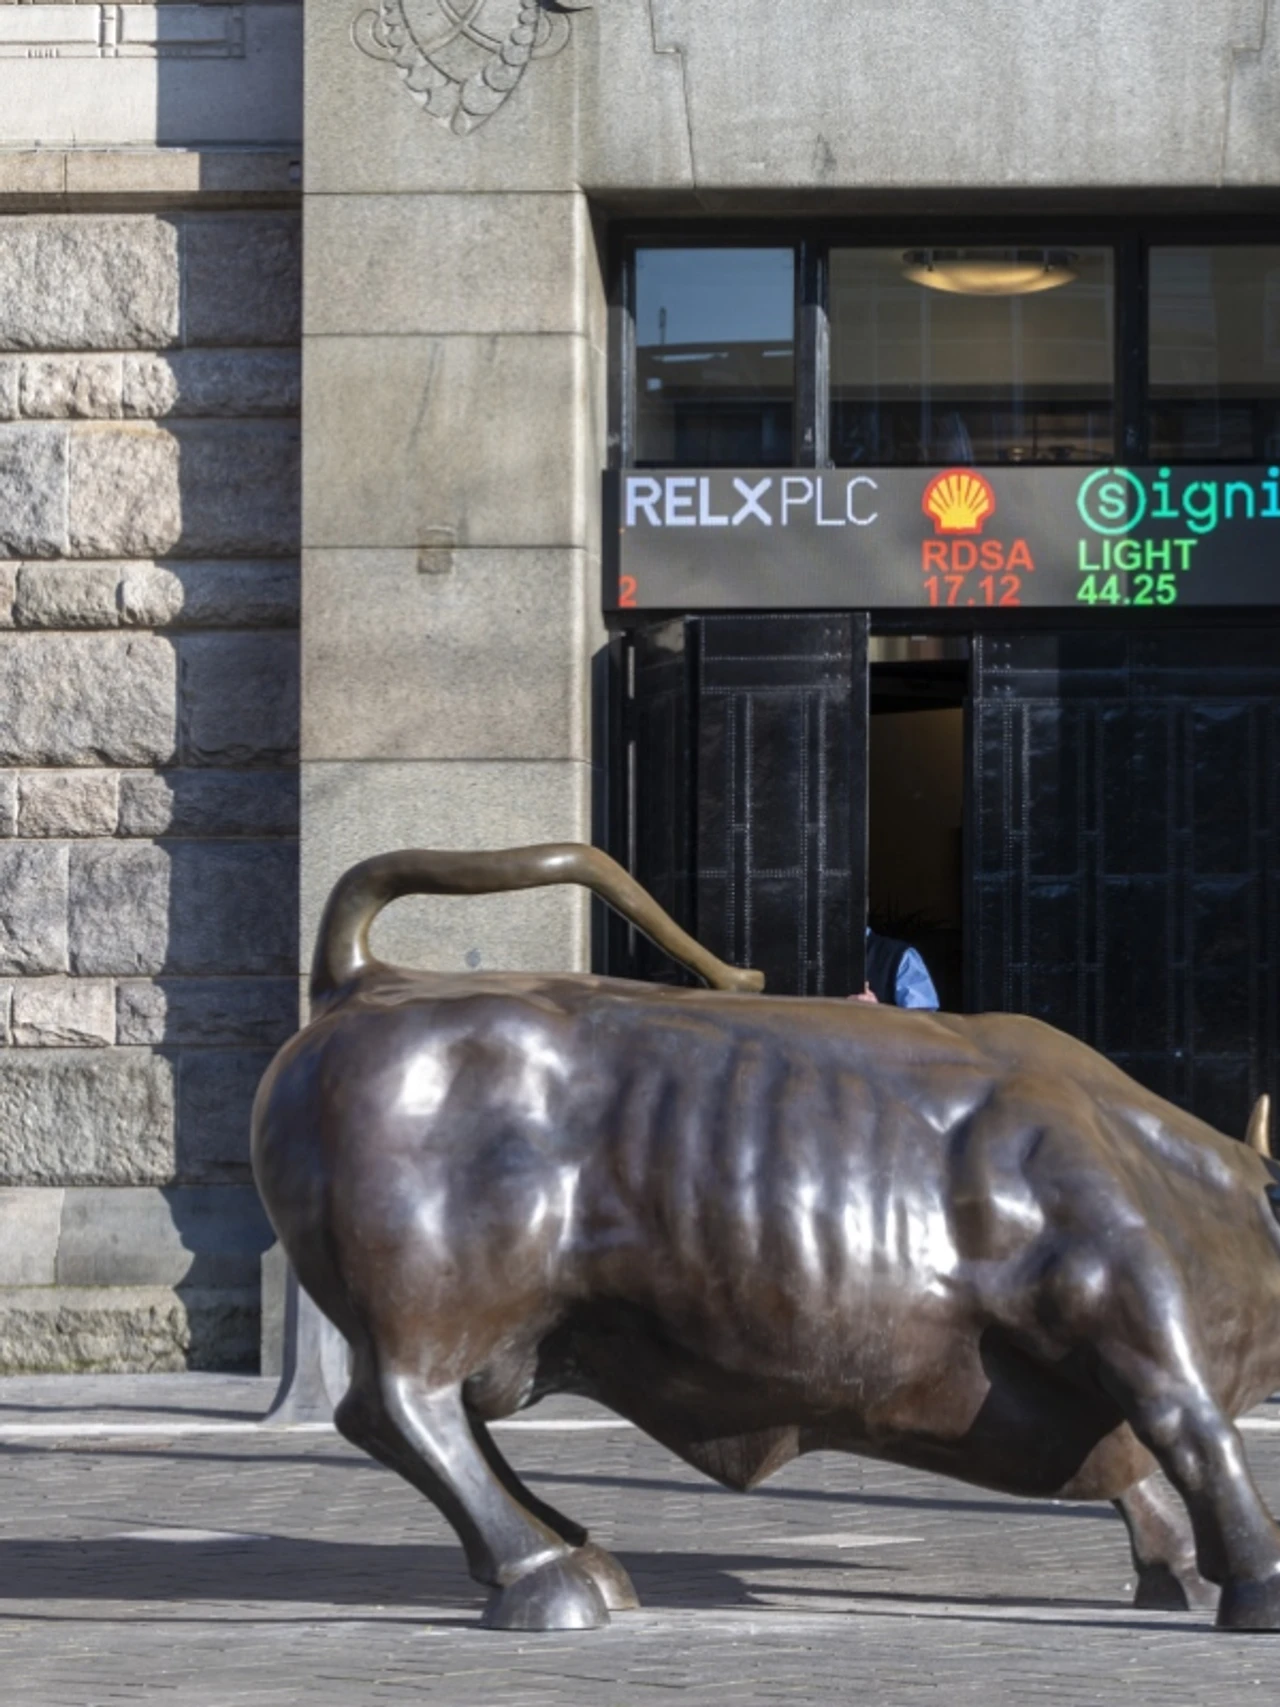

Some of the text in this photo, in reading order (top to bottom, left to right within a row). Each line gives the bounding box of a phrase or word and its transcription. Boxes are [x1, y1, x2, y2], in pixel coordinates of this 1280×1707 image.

[625, 476, 878, 526] RELX PLC
[921, 539, 1035, 572] RDSA
[1078, 539, 1198, 571] LIGHT
[923, 575, 1021, 606] 17.12
[1076, 574, 1177, 605] 44.25
